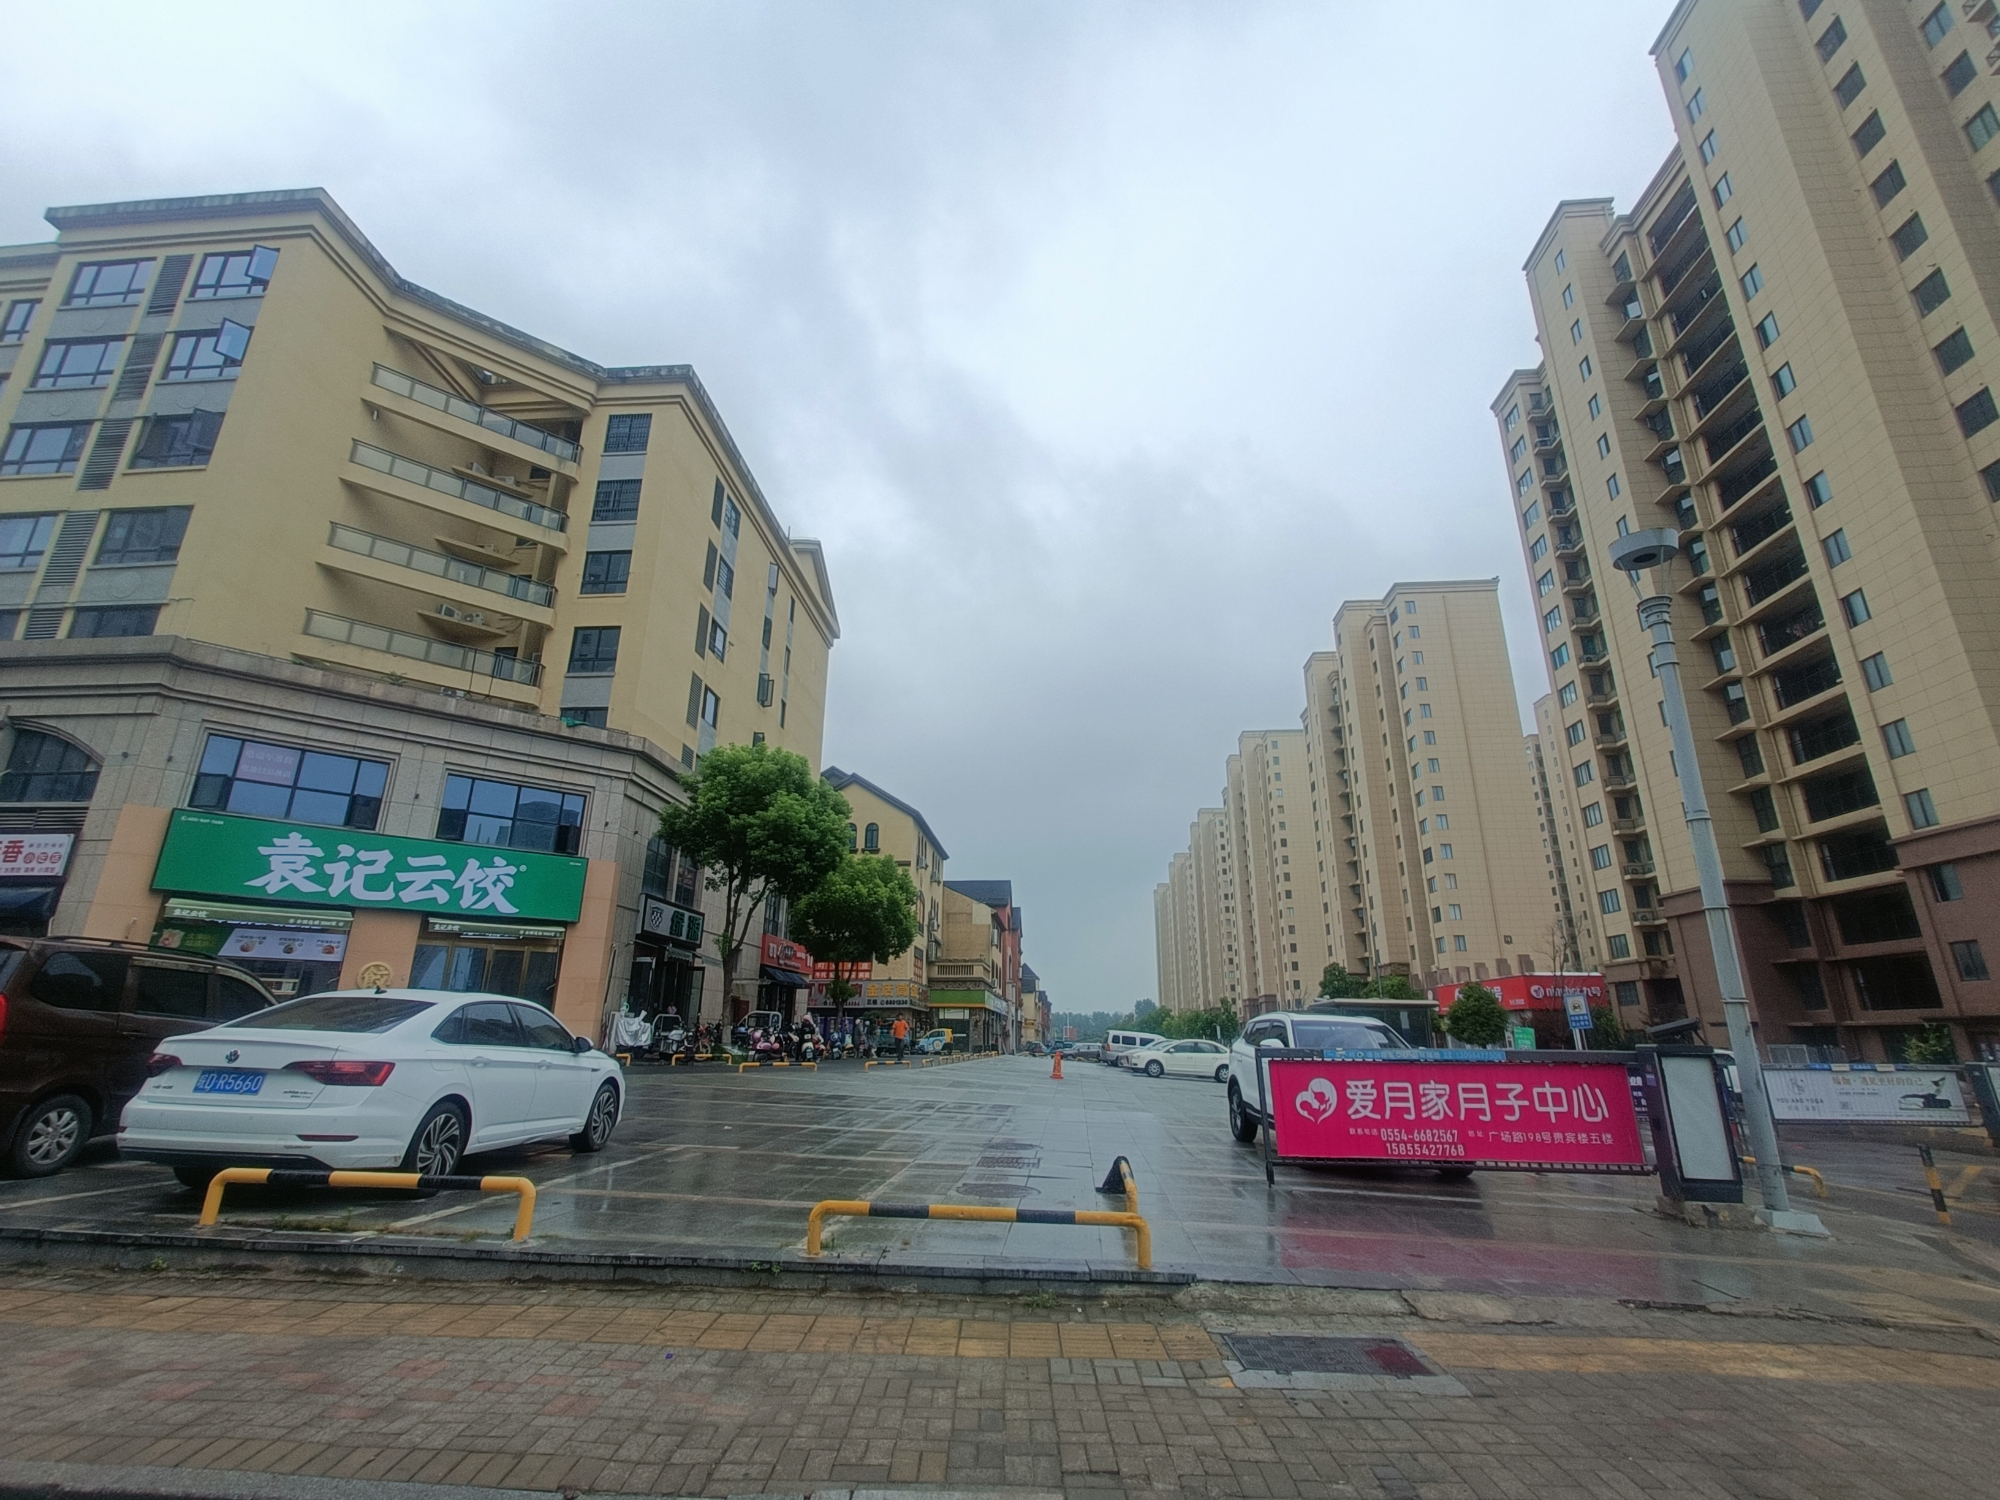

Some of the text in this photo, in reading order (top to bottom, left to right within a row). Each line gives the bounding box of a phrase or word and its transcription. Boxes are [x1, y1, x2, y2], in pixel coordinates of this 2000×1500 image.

[0, 840, 24, 863] 香
[243, 831, 520, 914] 袁记云饺
[1345, 1080, 1610, 1123] 爱月家月子中心
[1381, 1128, 1458, 1142] 0554-6682567
[1488, 1131, 1614, 1145] 广场路198号贵宾楼五楼
[1386, 1143, 1465, 1157] 15855427768
